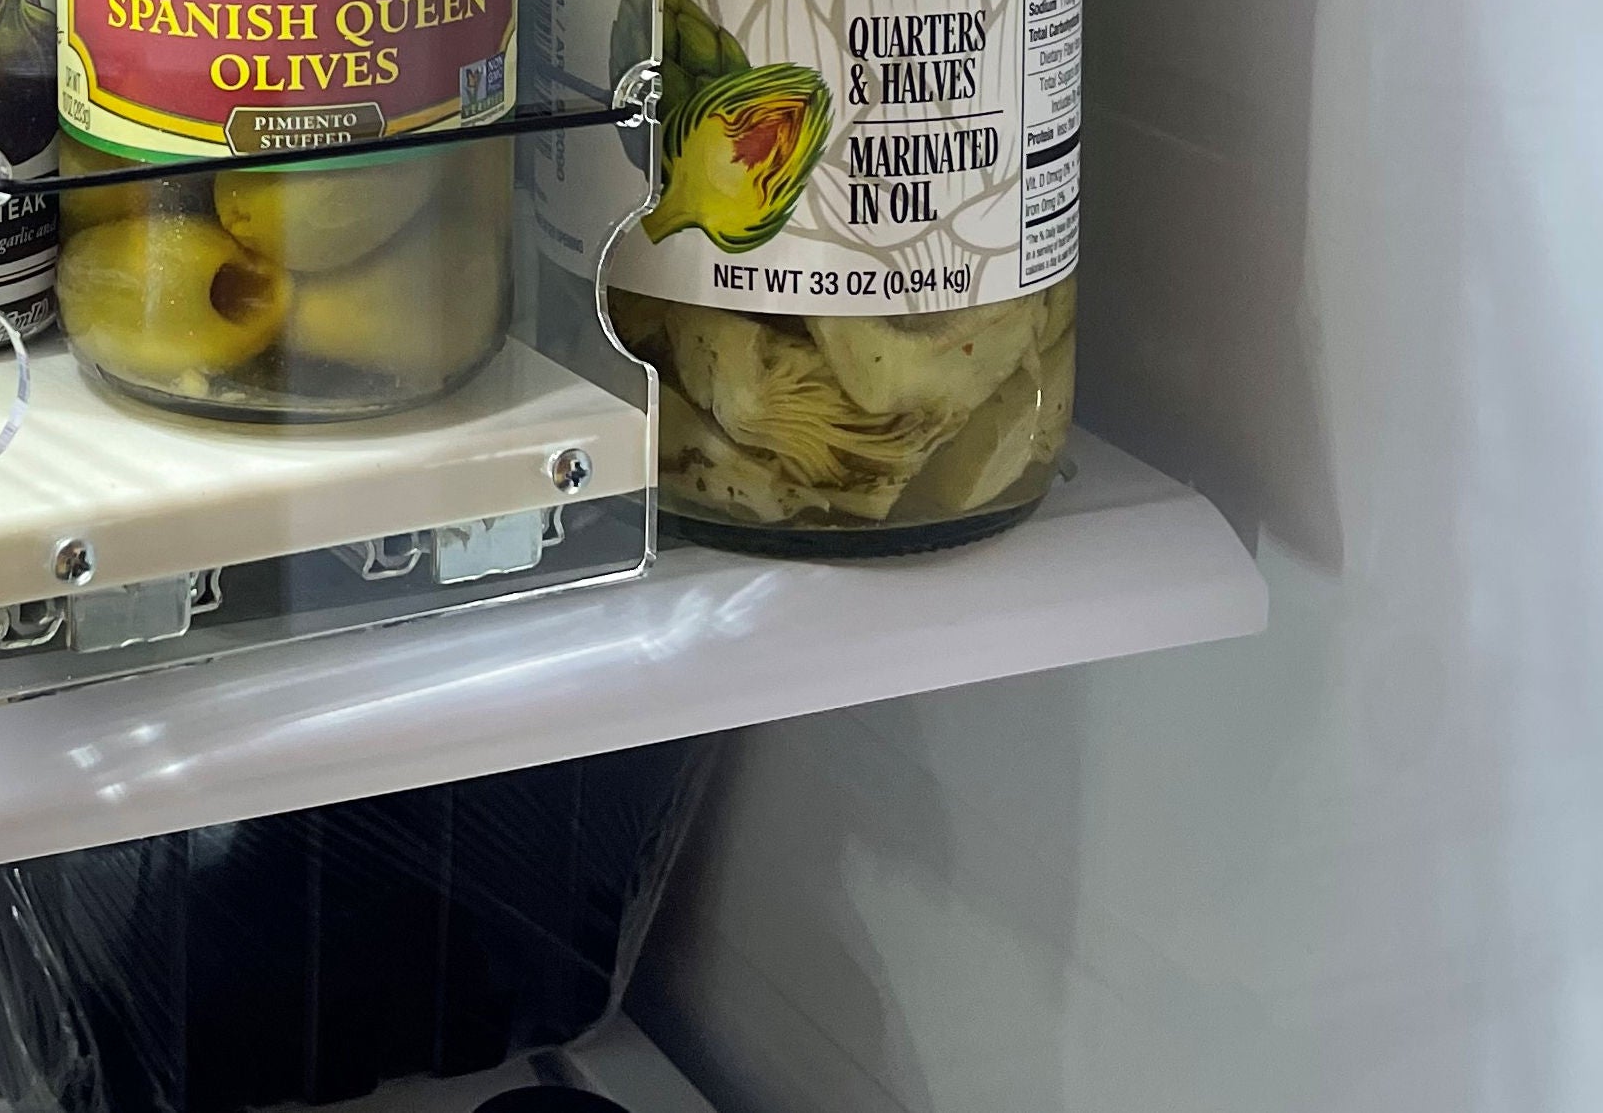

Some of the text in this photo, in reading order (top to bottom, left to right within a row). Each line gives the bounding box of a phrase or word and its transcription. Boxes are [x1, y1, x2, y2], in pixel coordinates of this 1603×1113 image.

[1029, 0, 1058, 17] Sodium
[848, 10, 987, 62] QUARTERS
[1029, 25, 1048, 43] Total
[209, 46, 400, 93] OLIVES
[848, 58, 977, 106] & HALVES
[254, 113, 357, 132] PIMIENTO
[260, 131, 352, 150] STUFFED
[848, 127, 1000, 179] MARINATED
[848, 180, 938, 225] IN OIL
[713, 263, 972, 300] NET WT 33 OZ (0.94 kg)
